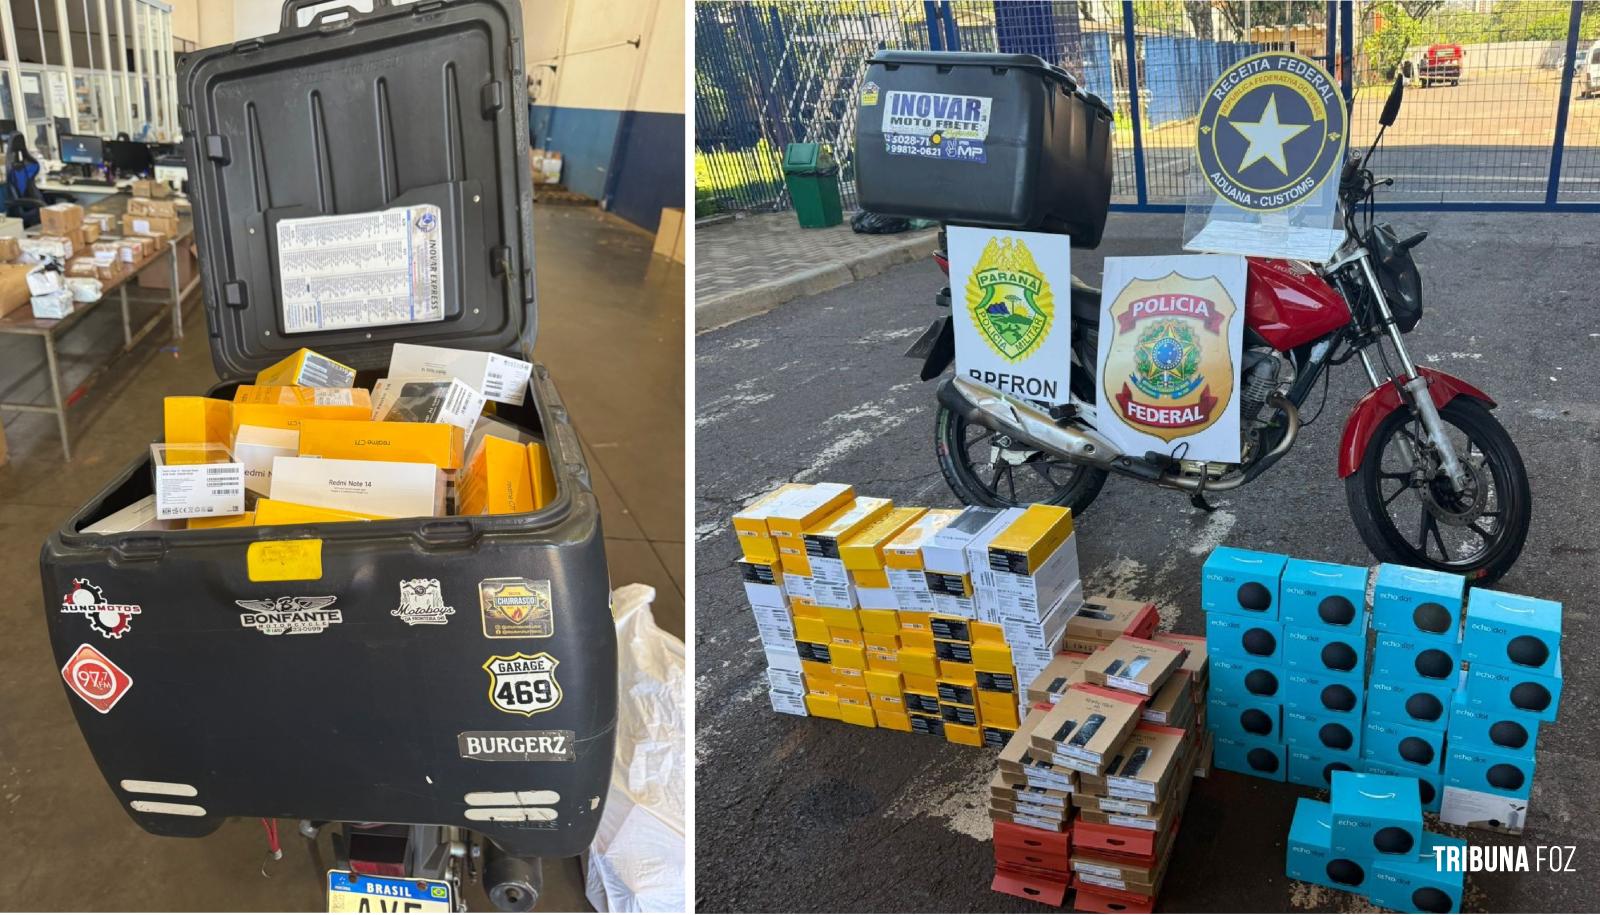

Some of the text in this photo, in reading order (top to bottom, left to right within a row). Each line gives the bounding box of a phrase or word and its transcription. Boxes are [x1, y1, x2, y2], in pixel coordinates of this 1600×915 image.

[1213, 57, 1334, 104] RECEITA FEDERAL
[891, 93, 981, 121] INOVAR
[890, 117, 979, 131] MOTO FRETE
[891, 145, 941, 156] 99812-0621
[1211, 171, 1251, 205] ADUANA
[1260, 176, 1315, 206] CUSTOMS
[429, 239, 439, 311] INOVAR EXPRESS
[979, 273, 1039, 290] PARANÁ
[1015, 318, 1043, 352] MILITAR
[1127, 401, 1204, 424] FEDERAL
[244, 468, 266, 478] edmi
[328, 479, 347, 487] Redmi
[1286, 587, 1304, 595] echo
[1379, 591, 1398, 600] echo
[497, 596, 535, 605] CHURRASCO
[391, 604, 455, 616] Motoboys
[243, 611, 340, 624] BONFANTE
[1211, 619, 1227, 627] echo
[1471, 621, 1507, 635] echo dot
[1290, 632, 1307, 641] echo
[1382, 639, 1400, 648] echo
[498, 660, 545, 673] GARAGE
[1475, 670, 1496, 680] echo
[496, 679, 553, 705] 469
[1455, 708, 1474, 718] echo
[1367, 722, 1385, 733] echo
[466, 736, 567, 755] BURGERZ
[1453, 752, 1473, 762] echo
[1338, 818, 1359, 828] echo
[366, 882, 412, 897] BRASIL
